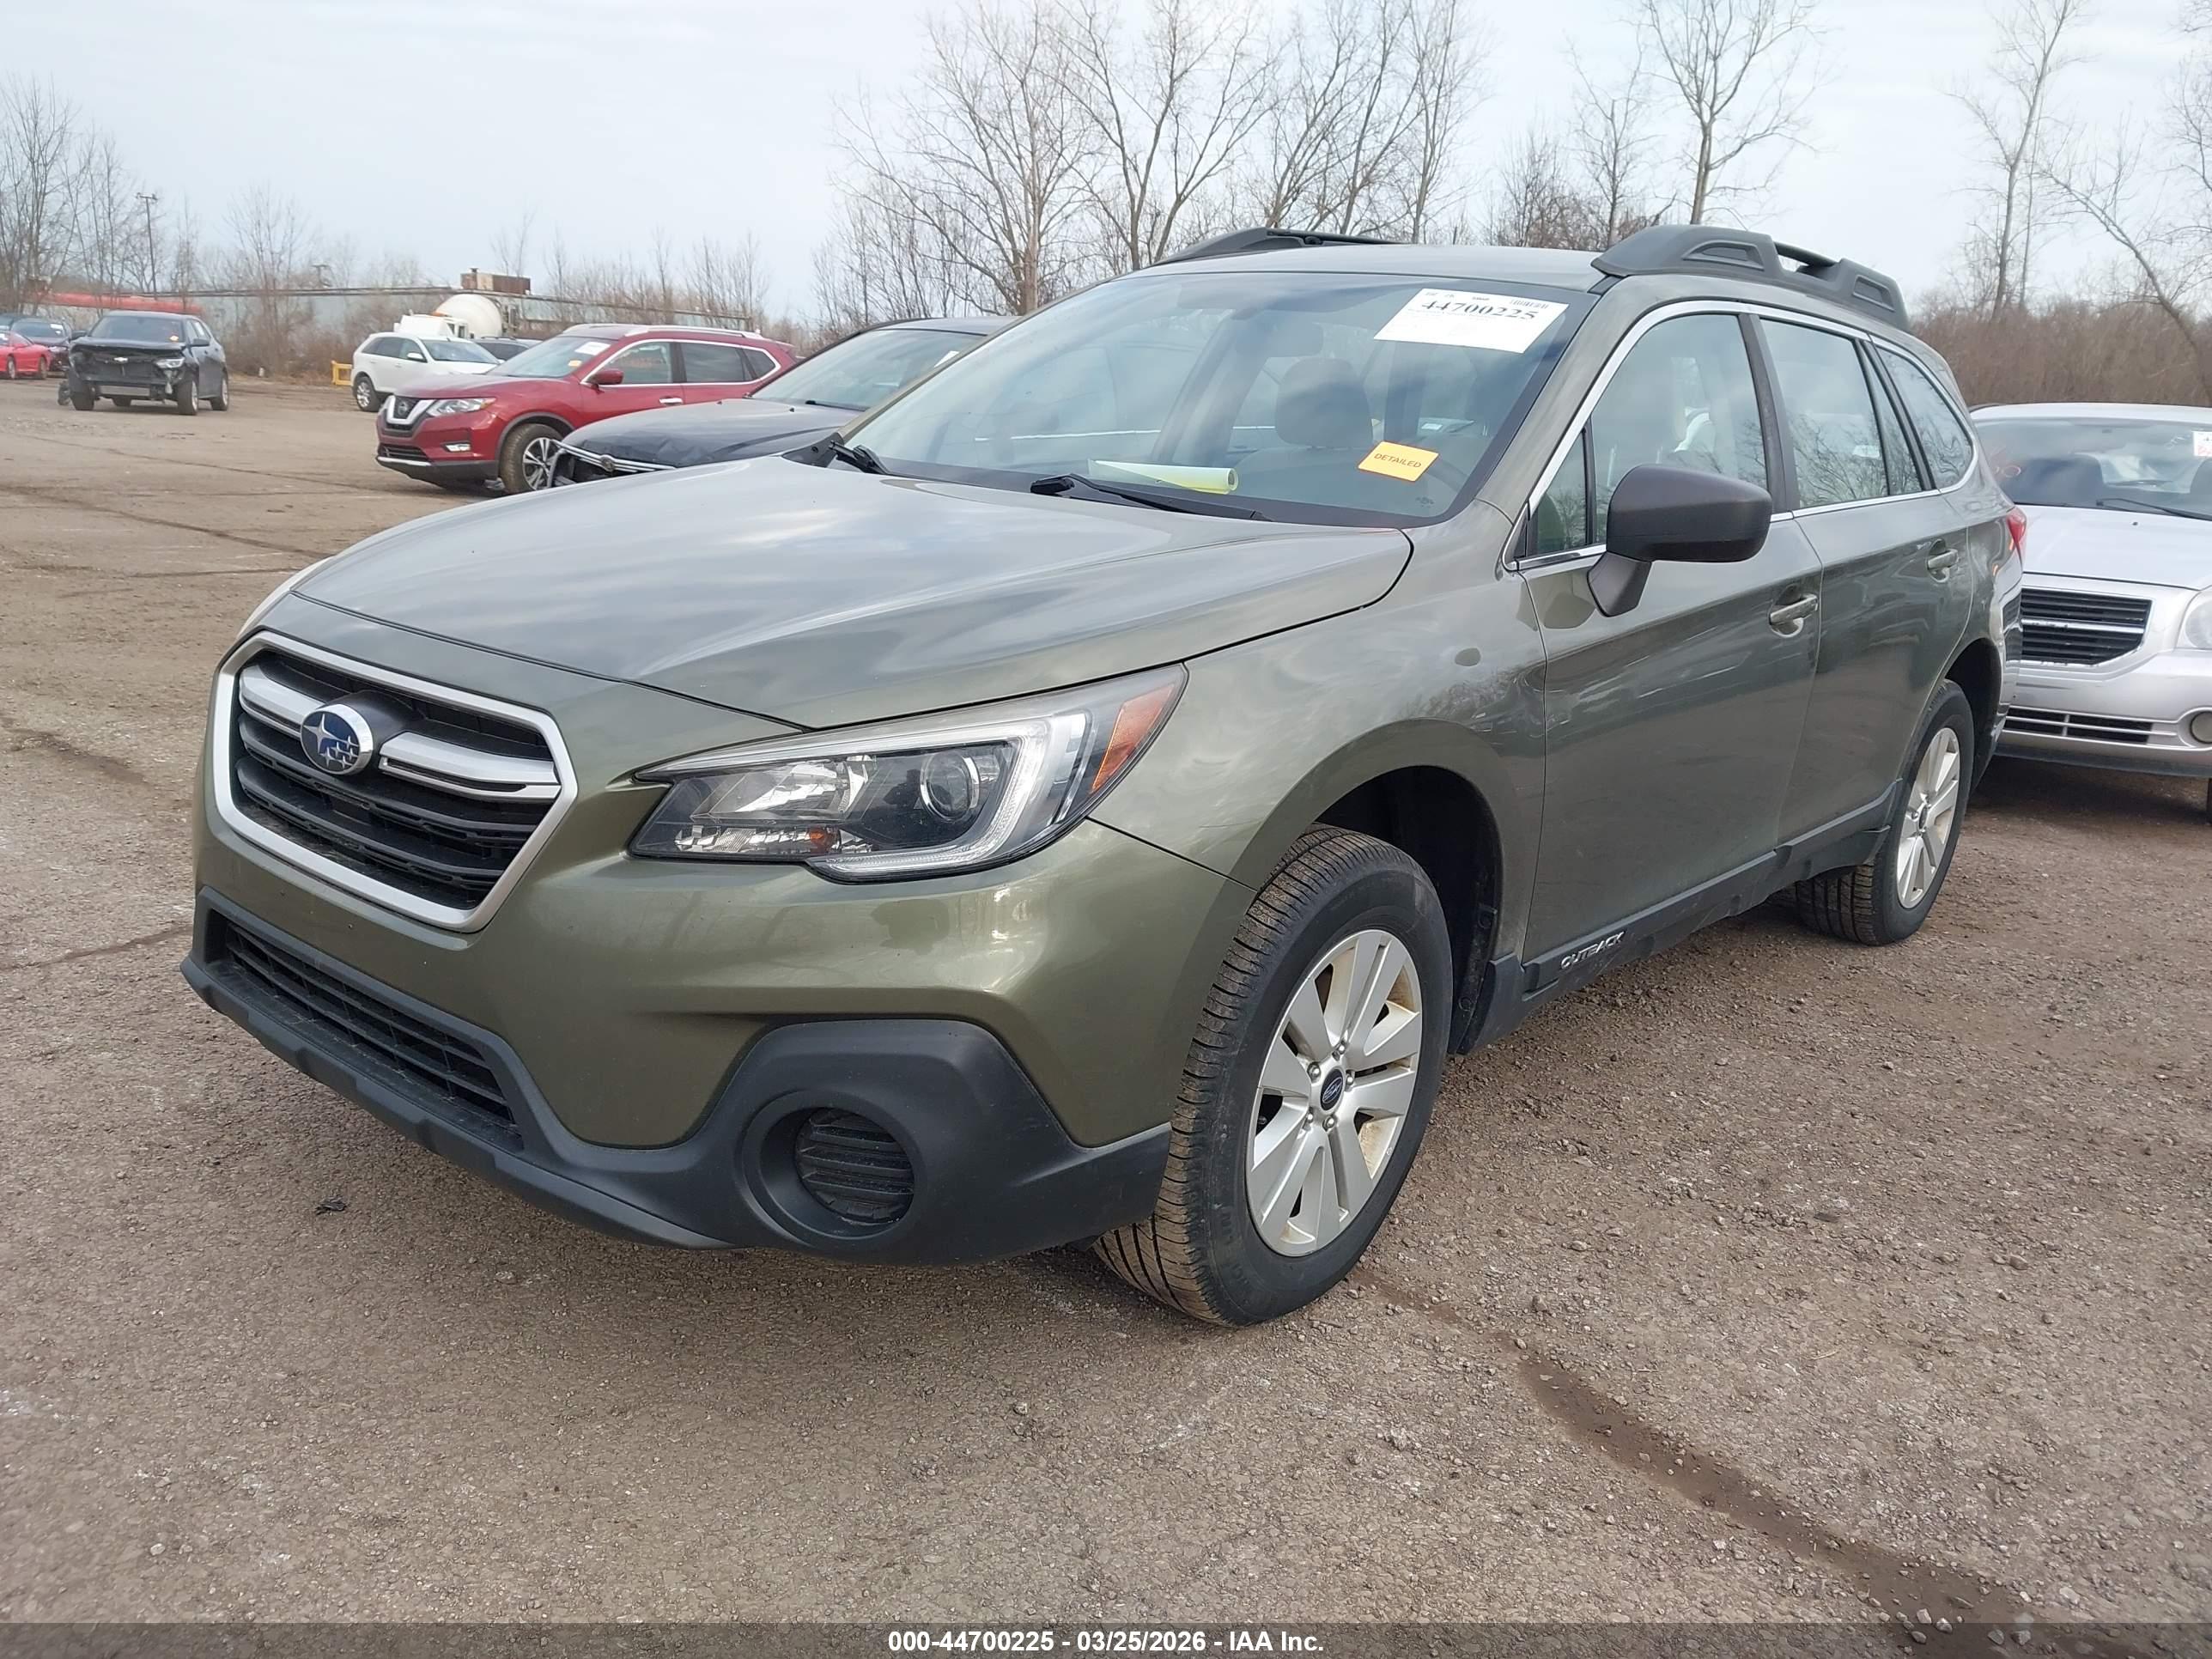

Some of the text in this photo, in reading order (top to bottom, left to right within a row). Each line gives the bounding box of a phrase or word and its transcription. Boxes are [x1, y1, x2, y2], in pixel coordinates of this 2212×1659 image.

[1421, 300, 1540, 320] 44700225
[1374, 453, 1422, 468] DETAILED
[1560, 931, 1625, 969] OUTBACK
